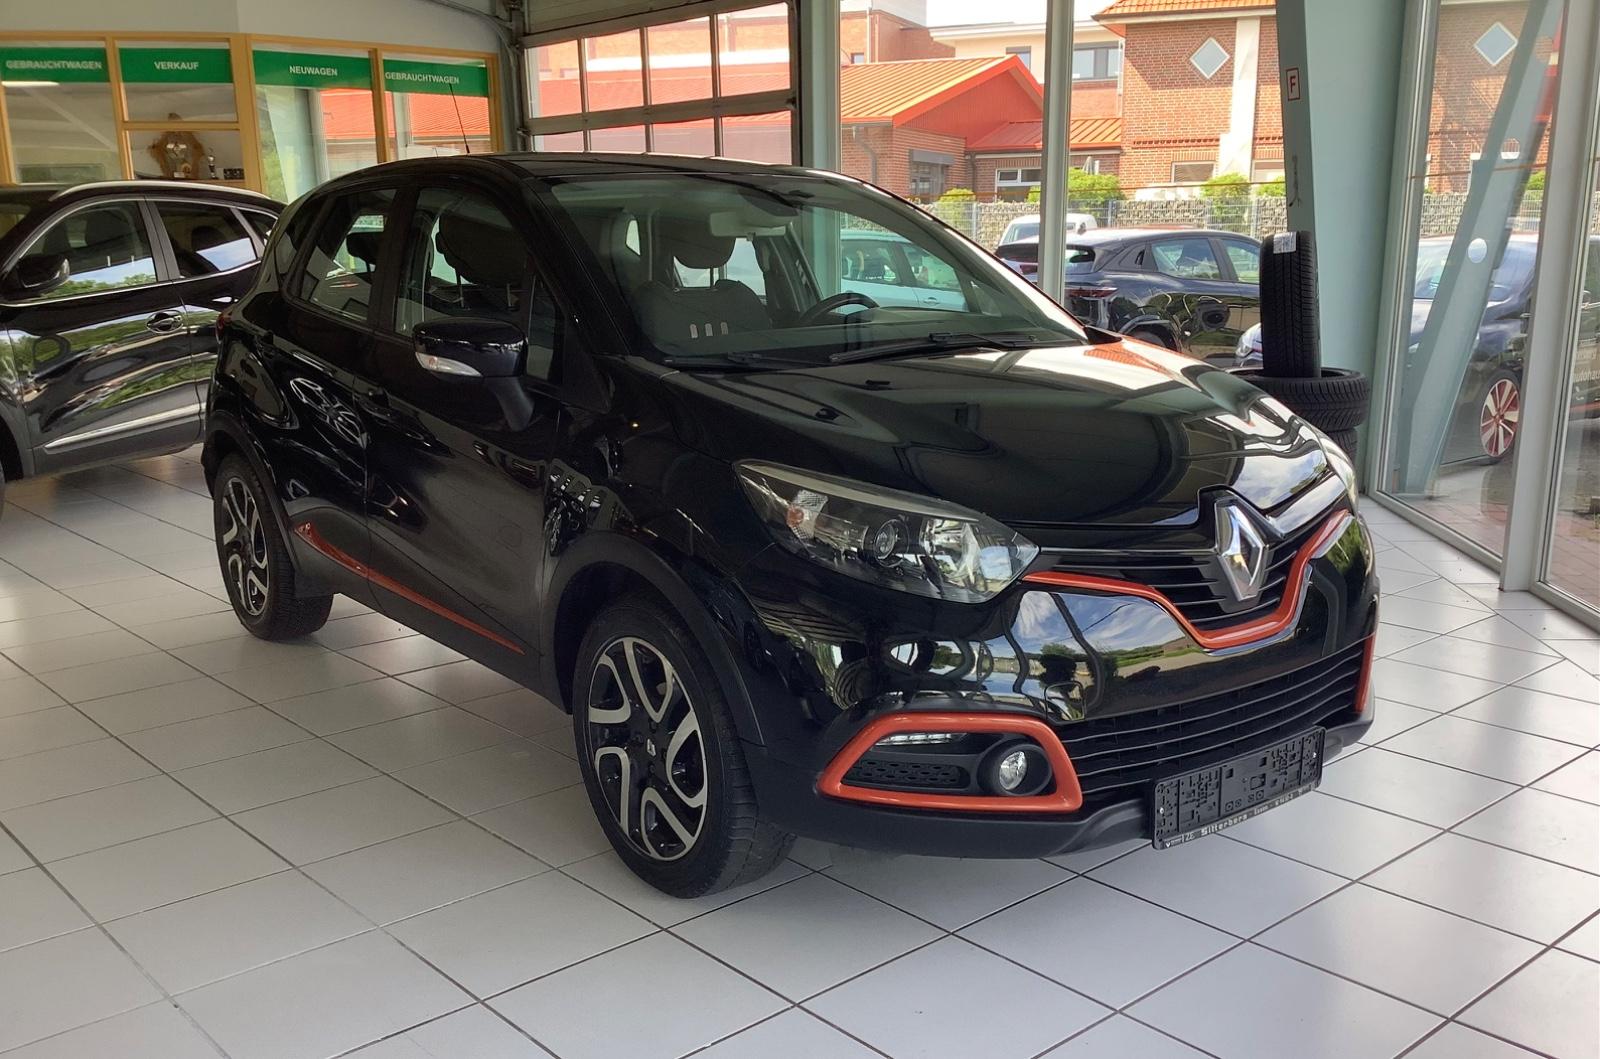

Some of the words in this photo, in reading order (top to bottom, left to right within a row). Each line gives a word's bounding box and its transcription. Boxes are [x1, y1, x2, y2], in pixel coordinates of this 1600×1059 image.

[6, 60, 102, 70] GEBRAUCHTWAGEN
[153, 61, 199, 70] VERKAUF
[289, 65, 338, 76] NEUWAGEN
[385, 72, 460, 84] GEBRAUCHTWAGEN
[1290, 76, 1296, 93] F
